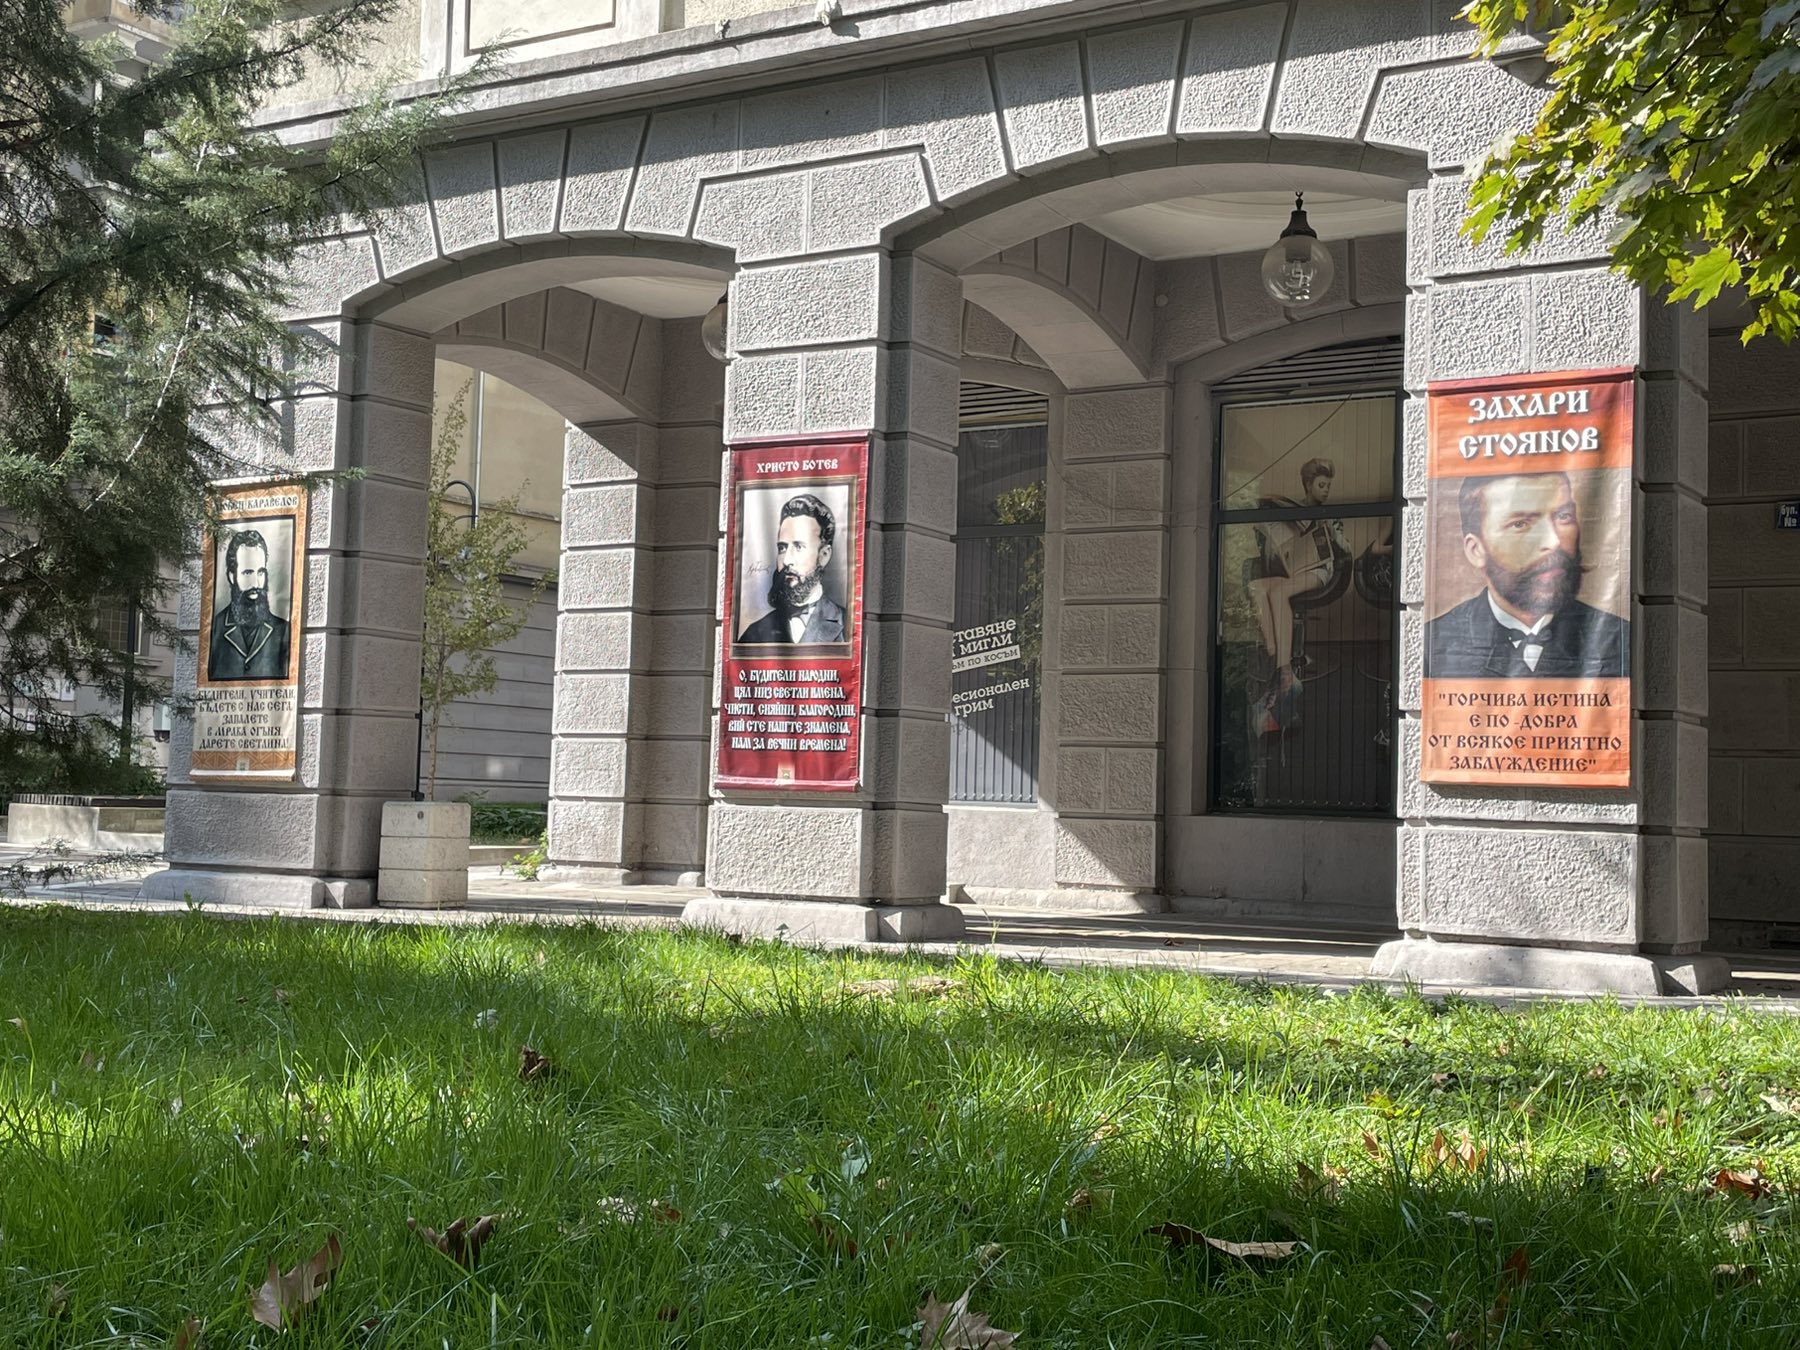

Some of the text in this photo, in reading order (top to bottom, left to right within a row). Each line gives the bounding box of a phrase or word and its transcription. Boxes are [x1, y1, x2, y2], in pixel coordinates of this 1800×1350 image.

[1468, 390, 1589, 423] ЗАХАРИ
[1459, 427, 1598, 458] СТОЯНОВ
[756, 459, 838, 473] ХРИСТО БОТЕВ
[247, 496, 298, 510] КАРАВЕЛОВ
[953, 619, 1017, 643] тавяне
[960, 633, 1013, 656] мигли
[750, 669, 796, 684] БУДИТЕЛИ
[734, 686, 751, 700] ЦЯЛ
[754, 686, 772, 699] НИЗ
[773, 687, 809, 699] СВЕТЛИ
[1438, 693, 1612, 707] "ГОРЧИВА ИСТИНА
[246, 701, 265, 712] НАС
[724, 703, 755, 716] ЧИСТИ,
[954, 699, 994, 717] грим
[222, 714, 269, 725] ЗАПАЛЕТЕ
[746, 721, 766, 732] СТЕ
[199, 739, 236, 750] ДАРЕТЕ
[731, 737, 847, 751] НАМ ЗА ВЕЧНИ ВРЕМЕНА!
[1428, 734, 1622, 750] ОТ ВСЯКОЕ ПРИЯТНО
[1450, 756, 1596, 773] ЗАБЛУЖДЕНИЕ"
